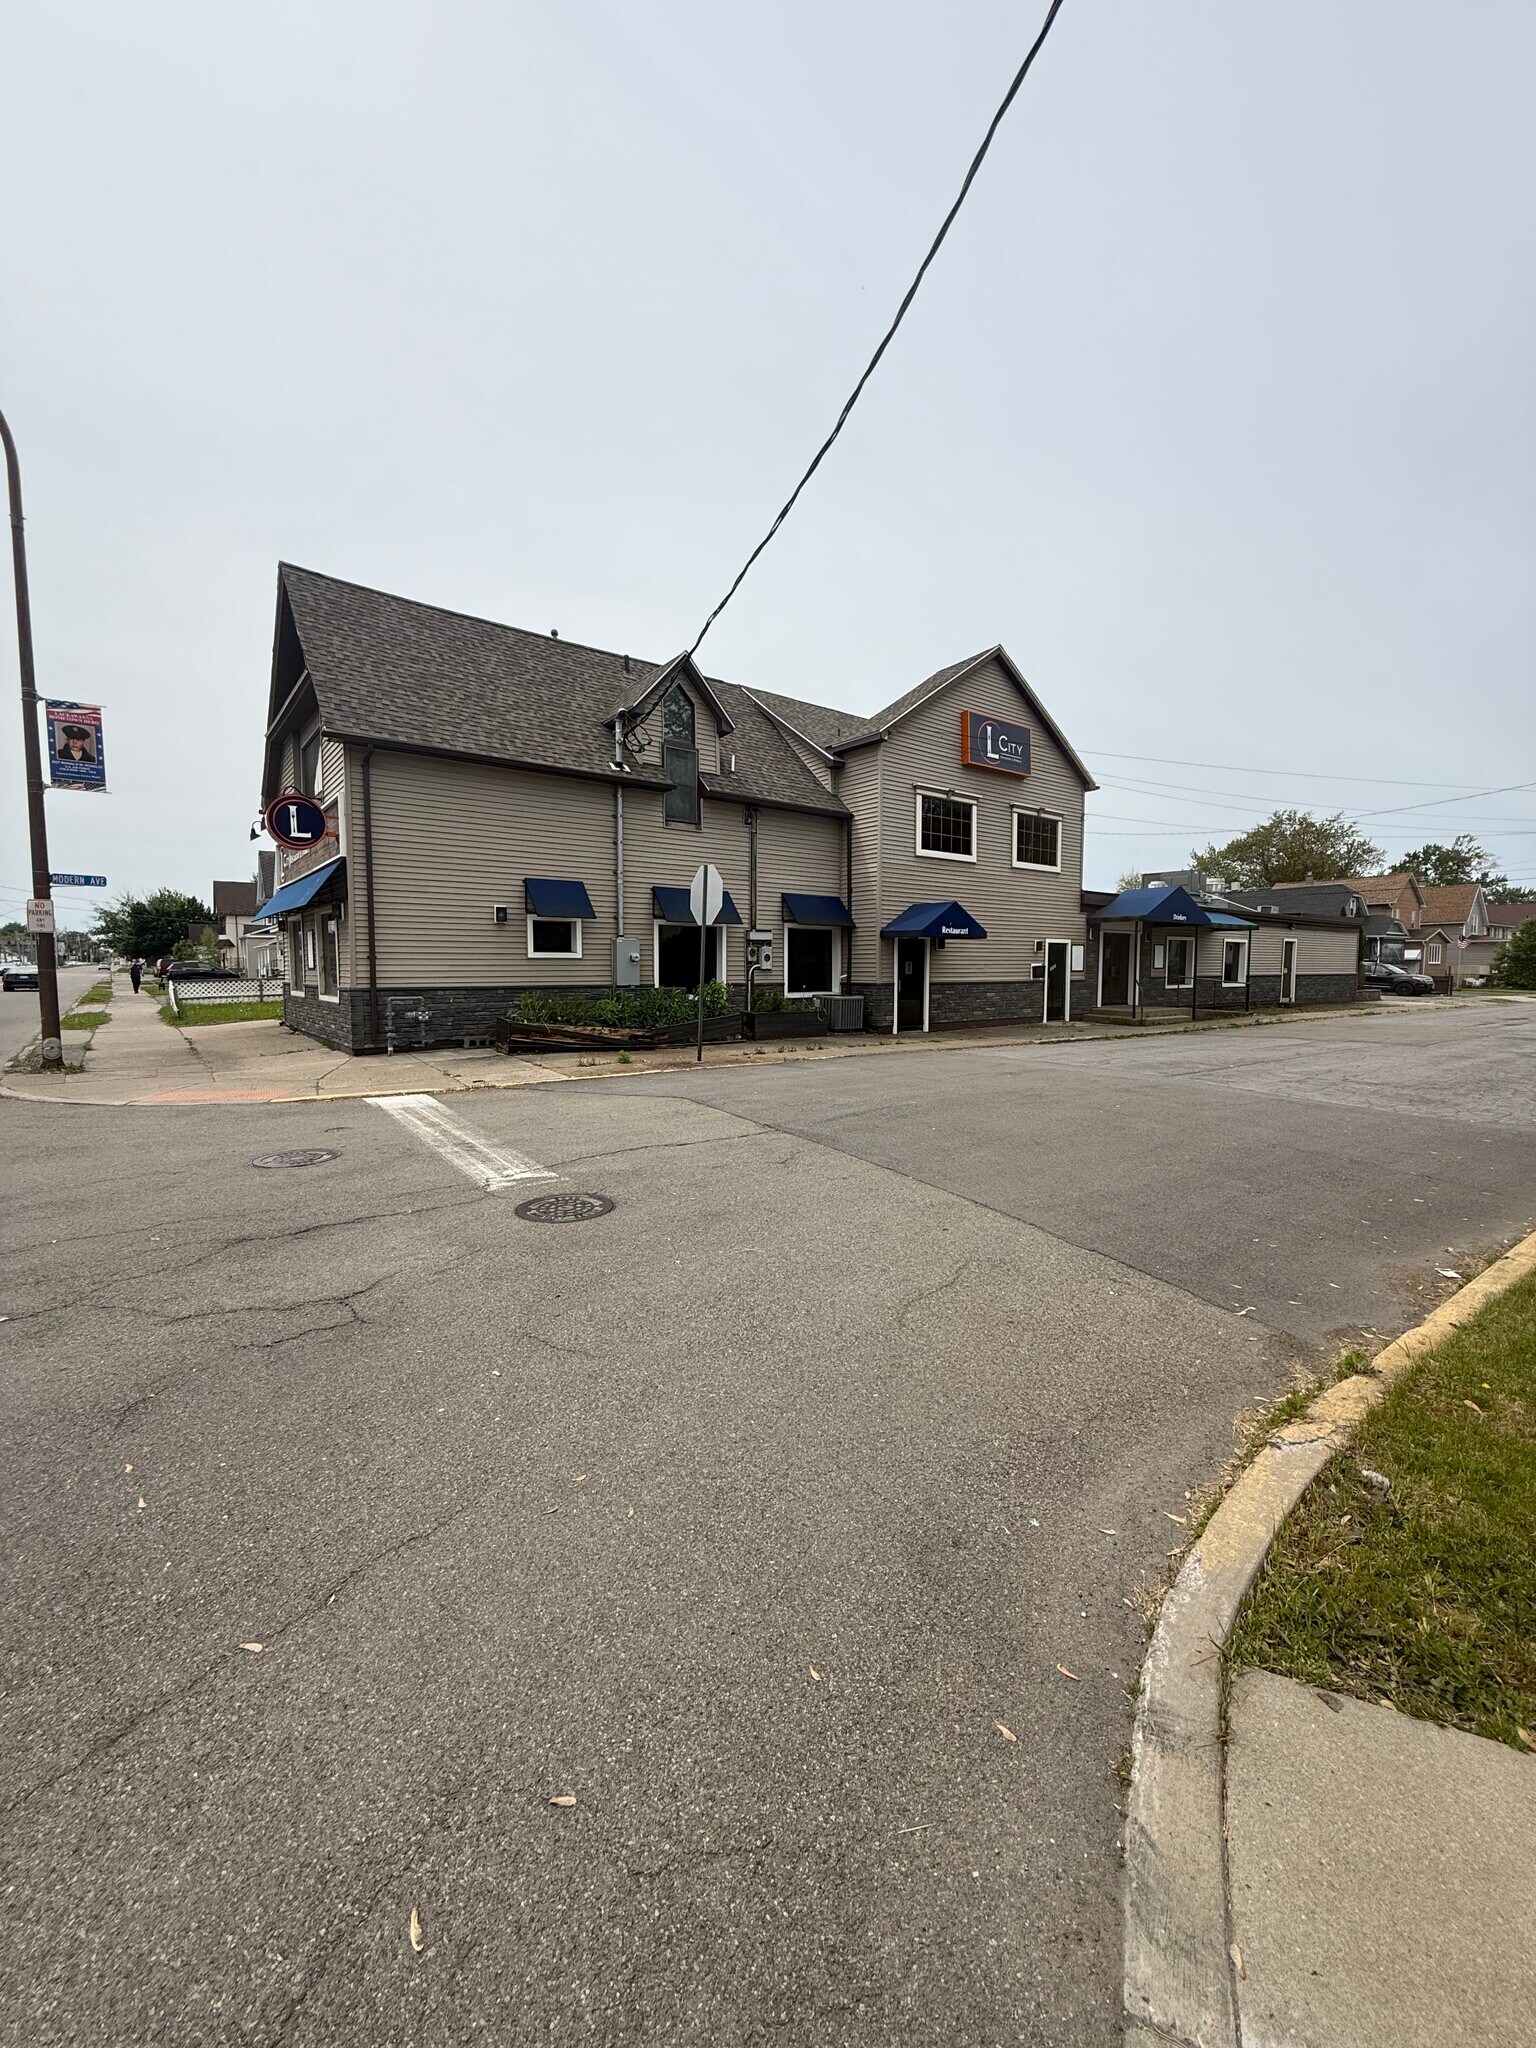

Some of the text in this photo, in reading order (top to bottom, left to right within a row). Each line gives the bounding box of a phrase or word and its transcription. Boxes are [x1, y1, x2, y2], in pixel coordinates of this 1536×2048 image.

[52, 874, 106, 886] MODERN AVE
[34, 901, 45, 910] NO
[28, 909, 53, 917] PARKING
[941, 925, 969, 935] Restaurant
